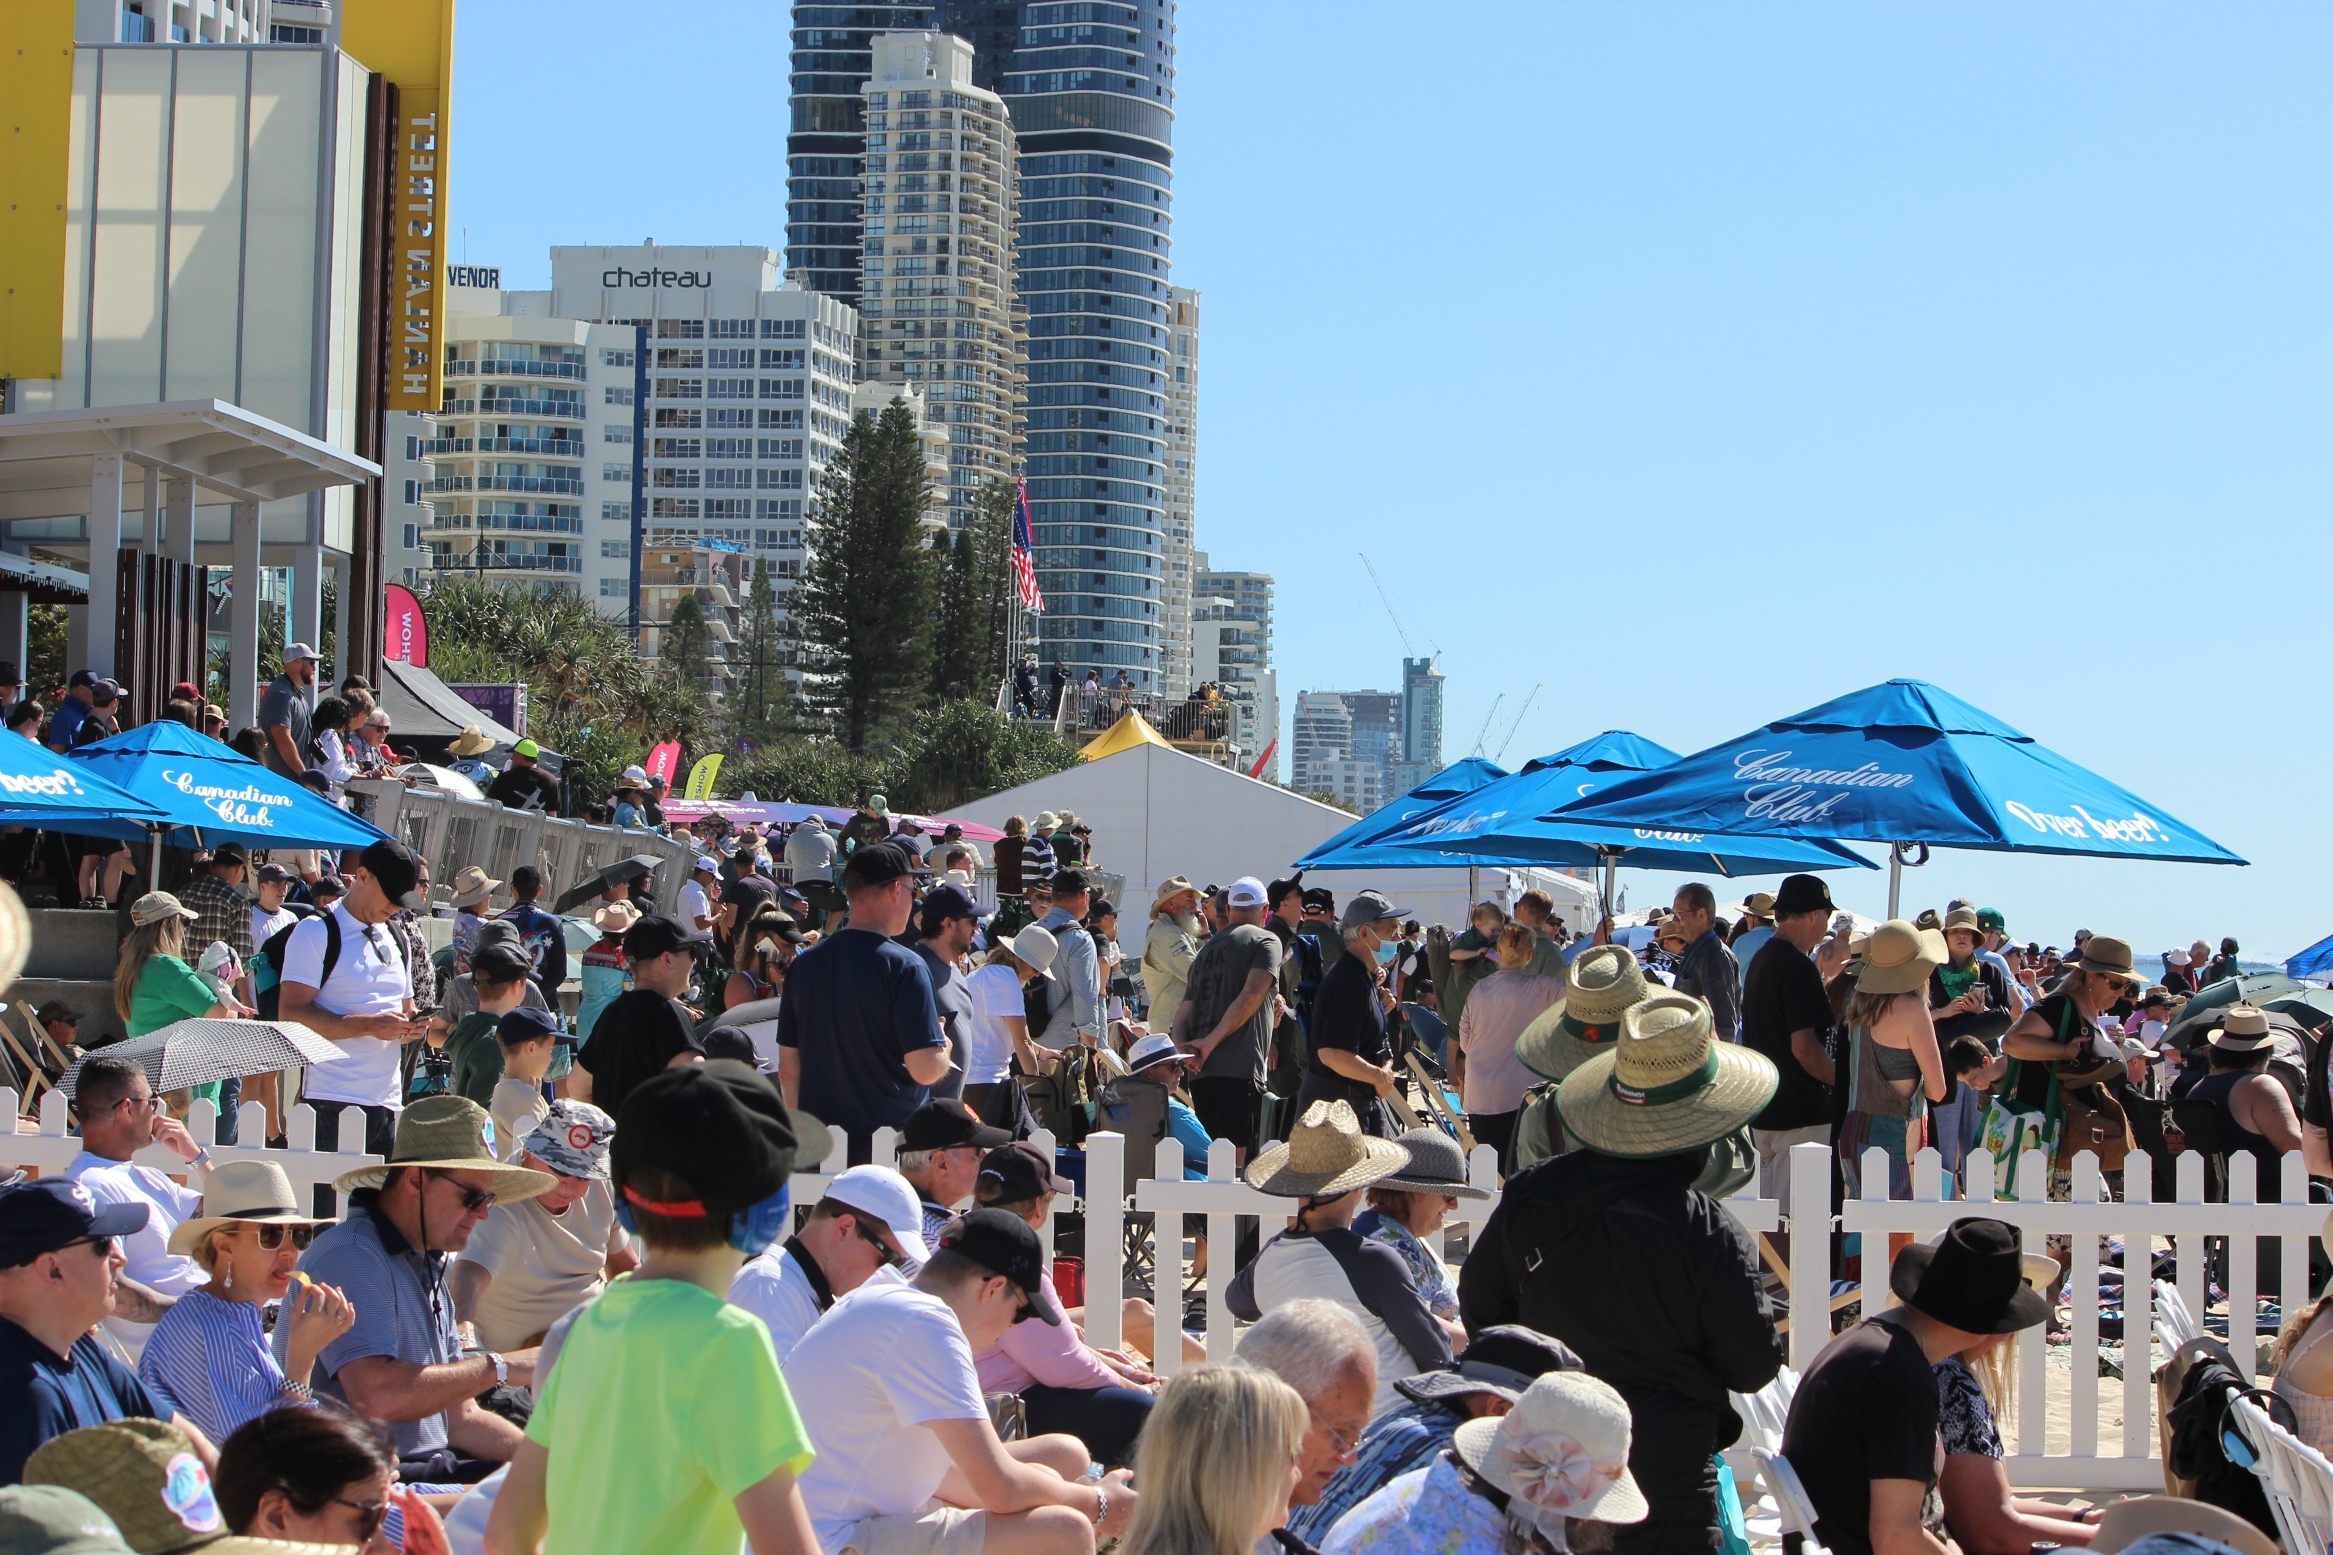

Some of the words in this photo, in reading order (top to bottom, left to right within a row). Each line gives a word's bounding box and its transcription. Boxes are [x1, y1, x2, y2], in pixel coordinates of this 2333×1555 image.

[602, 266, 712, 288] chateau
[1733, 749, 1914, 788] Canadian
[162, 770, 293, 807] Canadian
[2005, 800, 2090, 839] Over
